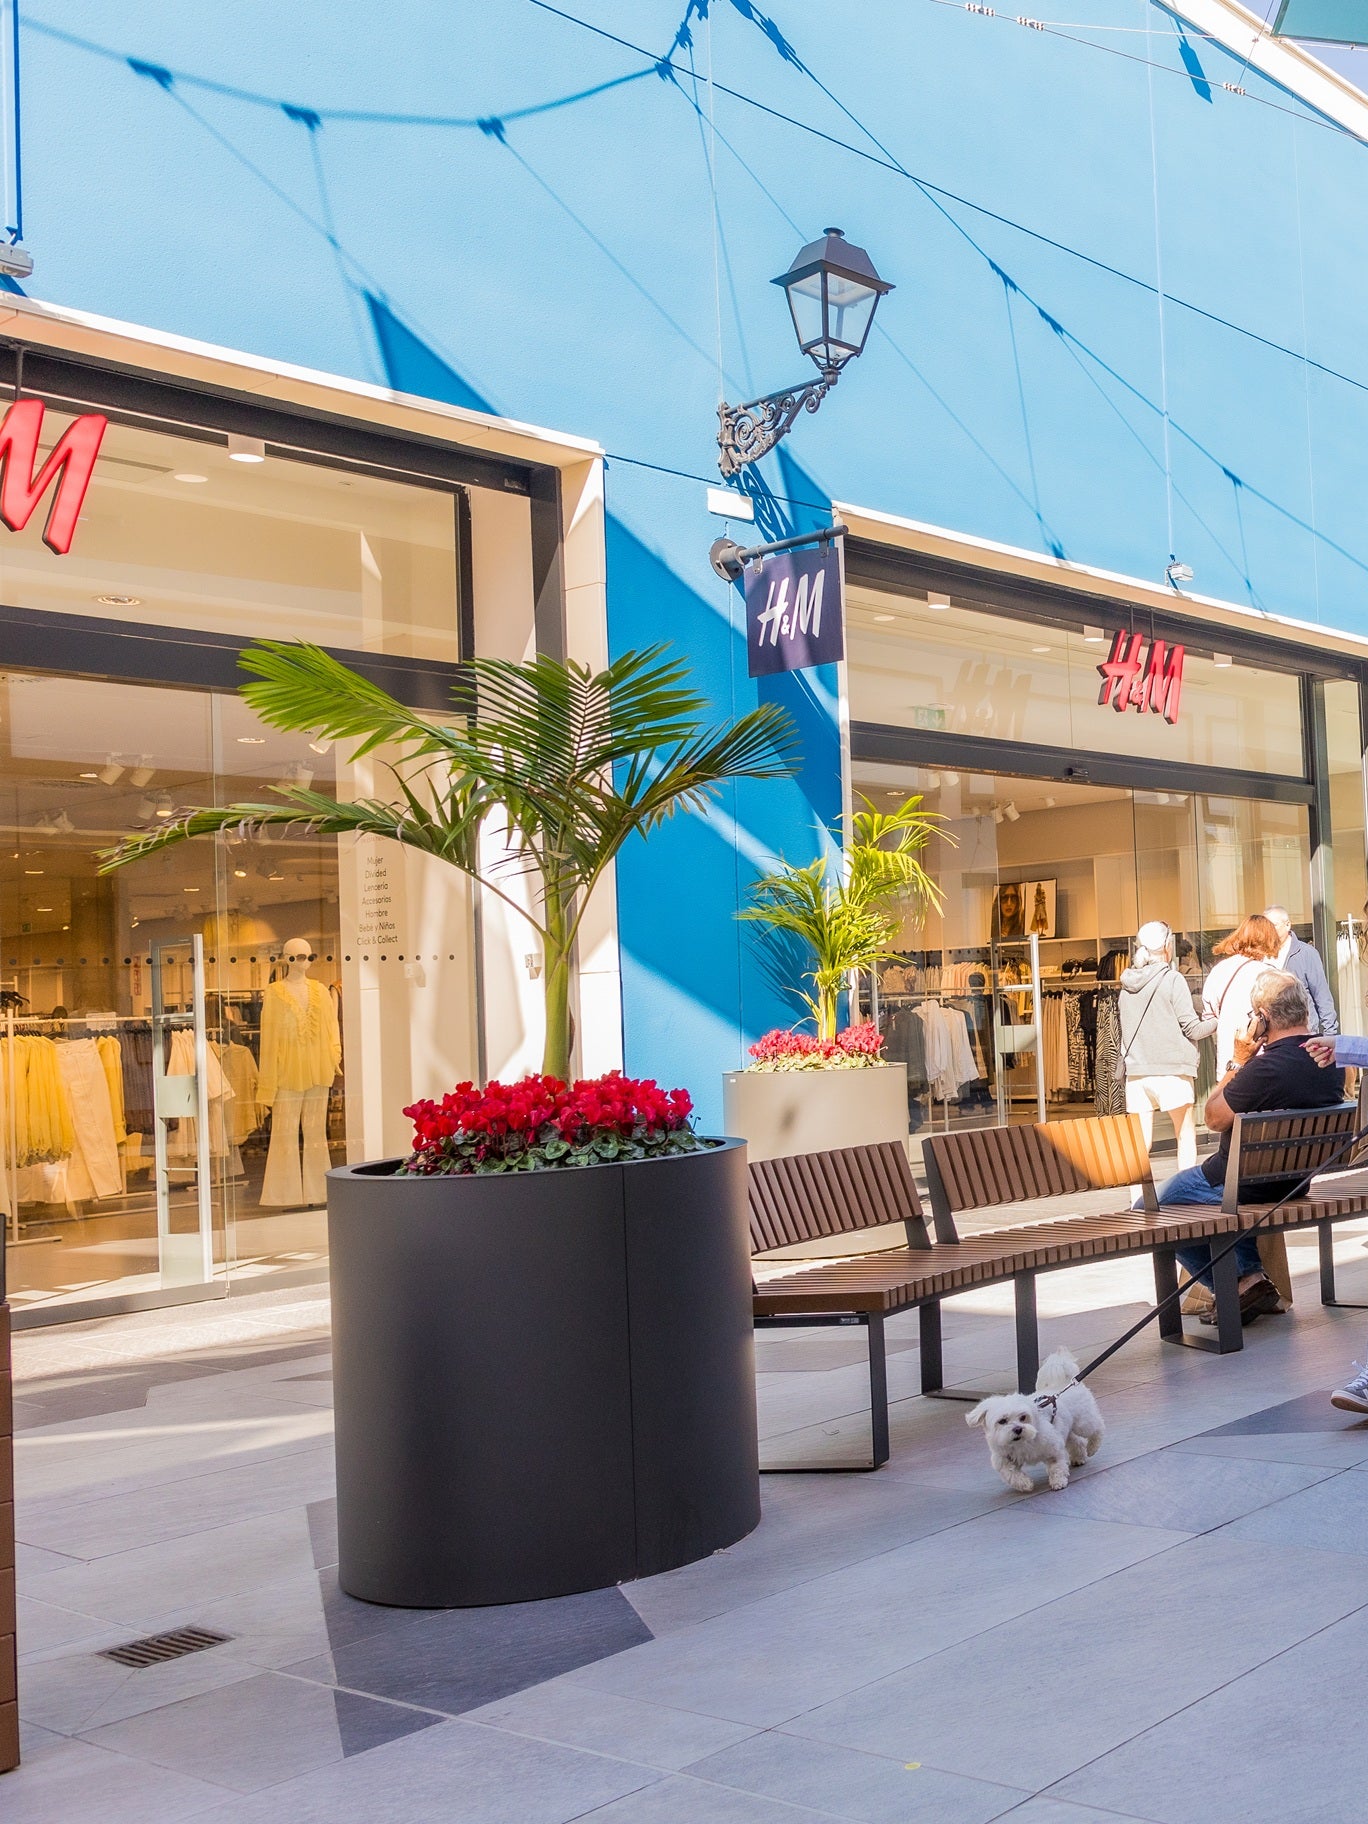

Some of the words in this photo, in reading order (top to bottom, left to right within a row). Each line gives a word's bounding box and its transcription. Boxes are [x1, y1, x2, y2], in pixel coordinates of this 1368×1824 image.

[756, 568, 826, 647] H&M
[1096, 628, 1185, 725] H&M
[367, 857, 384, 866] Mujer
[365, 869, 387, 879] Divided
[365, 910, 388, 919] Hombre
[377, 935, 398, 945] Collect
